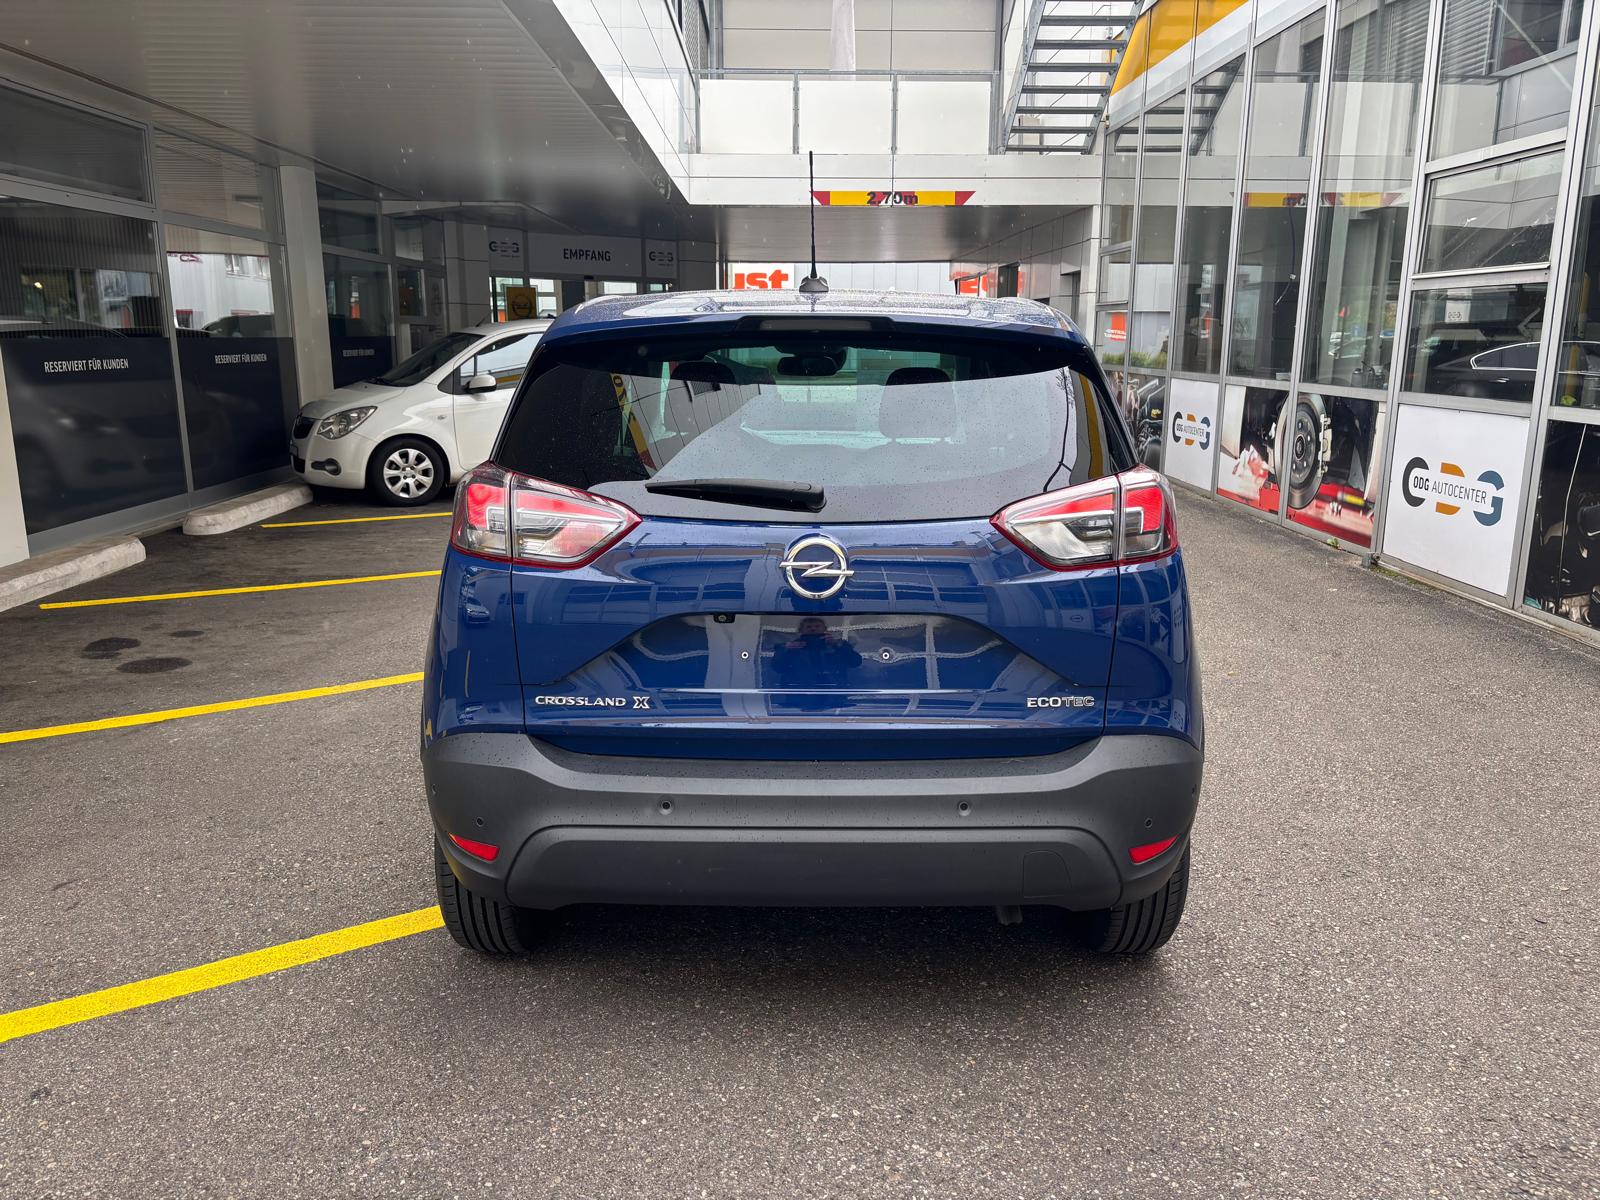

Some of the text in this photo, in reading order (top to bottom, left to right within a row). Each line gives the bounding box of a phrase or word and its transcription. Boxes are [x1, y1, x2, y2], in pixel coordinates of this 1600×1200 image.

[563, 248, 611, 262] EMPFANG
[44, 357, 129, 373] RESERVIERT FÜR KUNDEN
[214, 354, 241, 364] RESERVIERT
[1413, 475, 1487, 505] ODG AUTOCENTER
[535, 695, 651, 709] CROSSLAND X
[1026, 695, 1095, 708] ECOTEC
